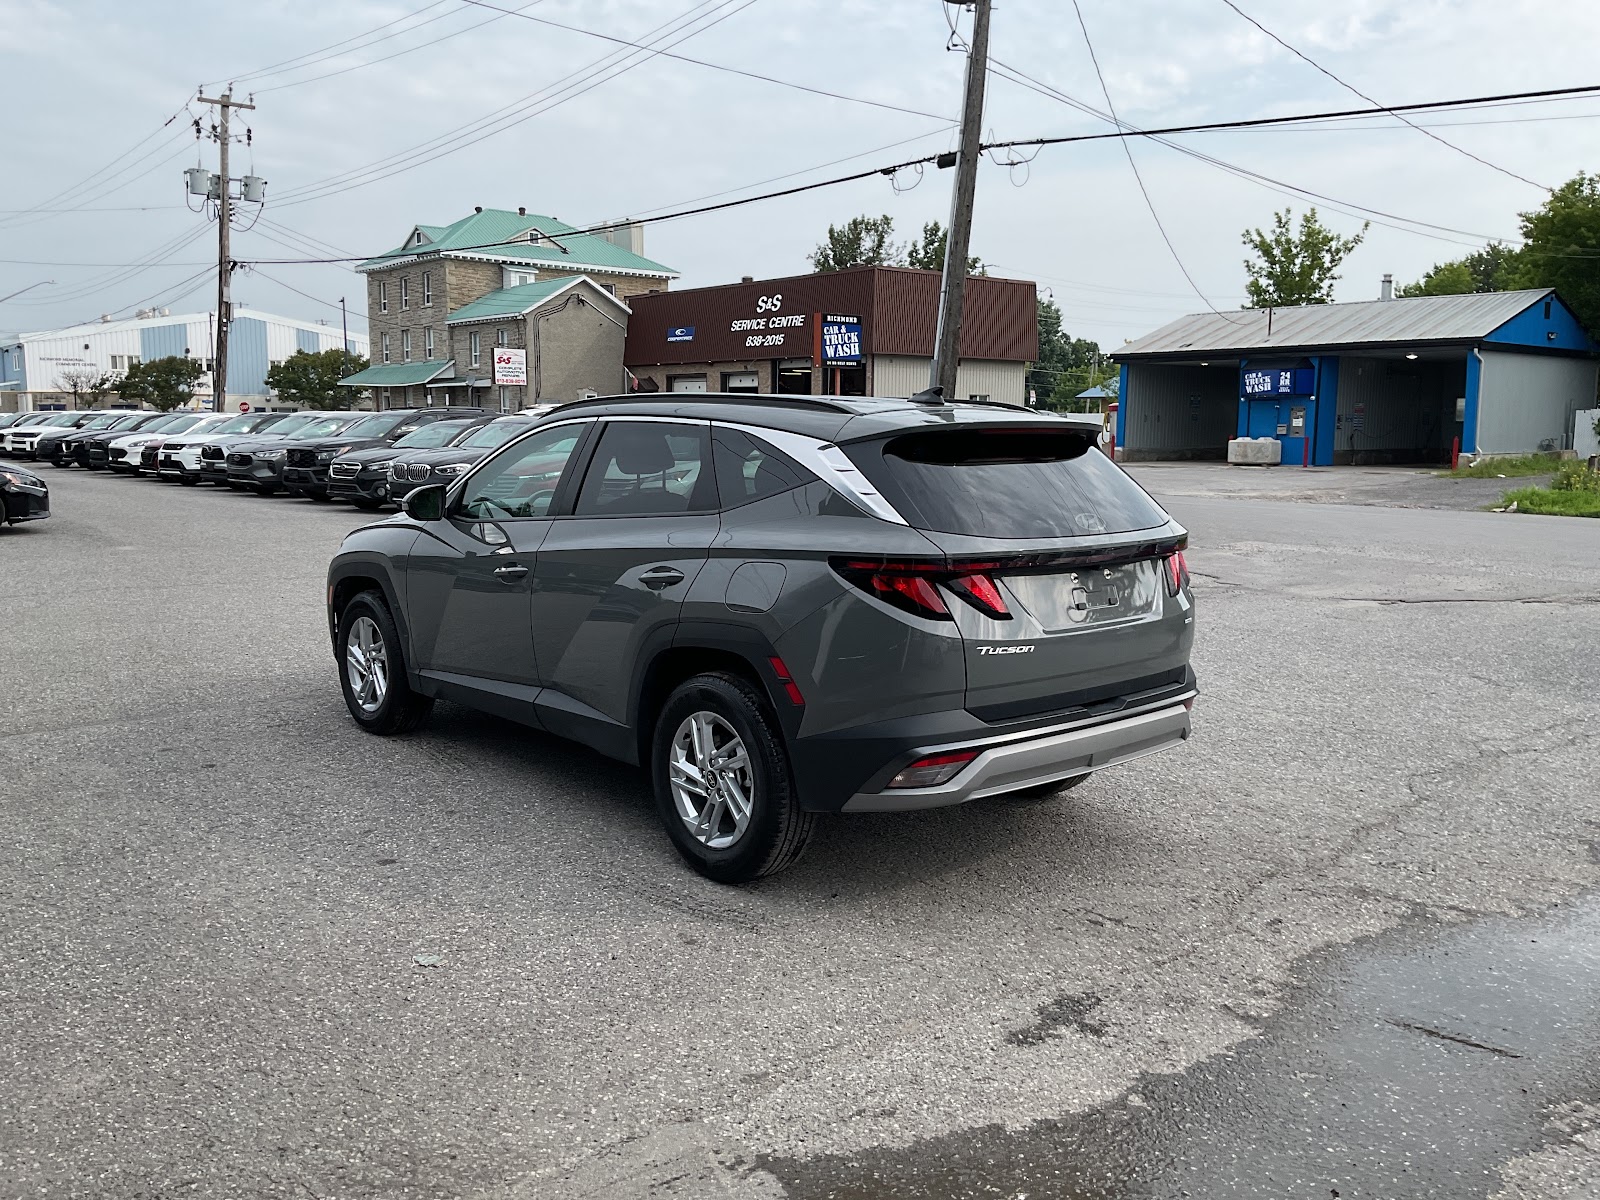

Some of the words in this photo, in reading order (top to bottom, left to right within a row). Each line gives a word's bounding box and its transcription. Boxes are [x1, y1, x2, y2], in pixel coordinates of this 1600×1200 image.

[756, 294, 782, 313] S&S
[730, 318, 767, 331] SERVICE
[769, 315, 805, 328] CENTRE
[827, 315, 857, 323] RICHMOND
[824, 325, 839, 335] CAR
[840, 324, 847, 333] &
[745, 334, 785, 347] 838-2015
[824, 332, 859, 345] TRUCK
[825, 343, 860, 358] WASH
[496, 356, 512, 365] S&S
[1245, 376, 1271, 385] TRUCK
[1245, 383, 1271, 393] WASH
[976, 645, 1035, 655] Tucson
